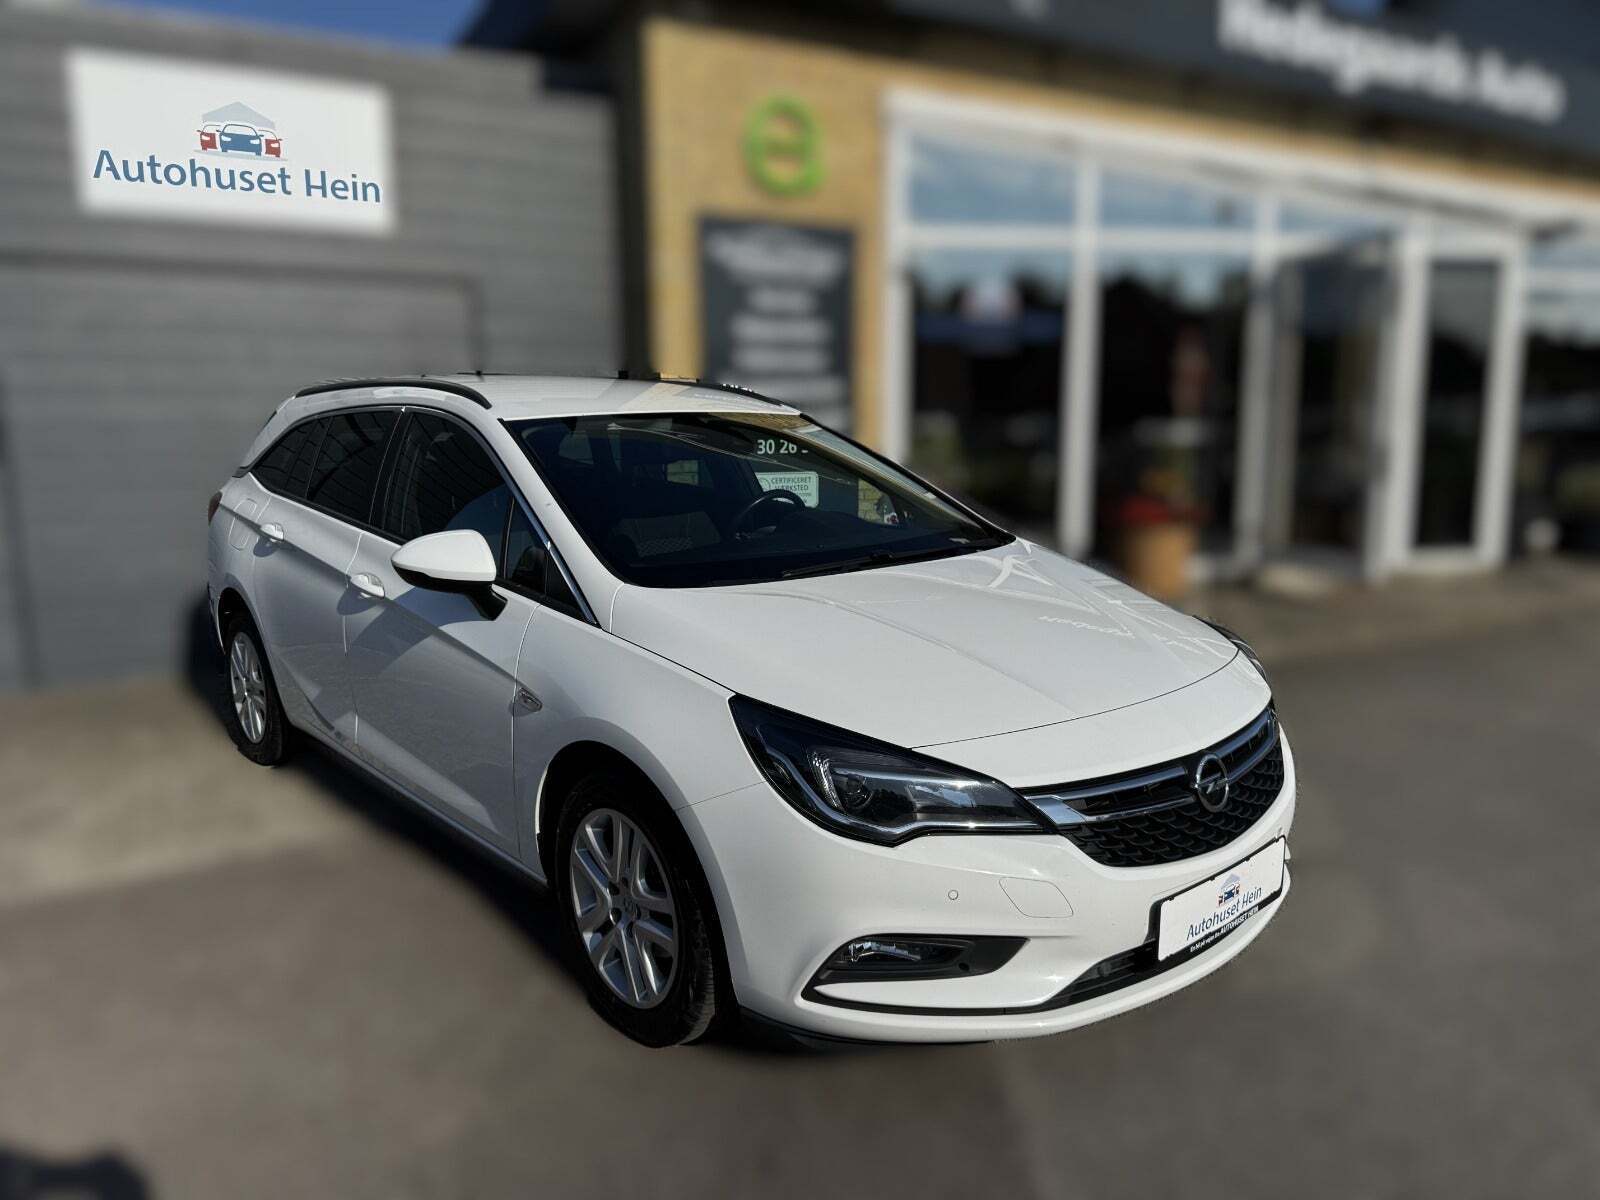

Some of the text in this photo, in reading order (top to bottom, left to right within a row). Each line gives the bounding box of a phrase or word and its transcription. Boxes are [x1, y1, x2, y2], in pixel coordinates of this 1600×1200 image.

[93, 149, 381, 203] Autohuset Hein
[757, 439, 797, 455] 30 26
[771, 476, 812, 484] CERTIFICERET
[1186, 886, 1262, 941] Autohuset Hein
